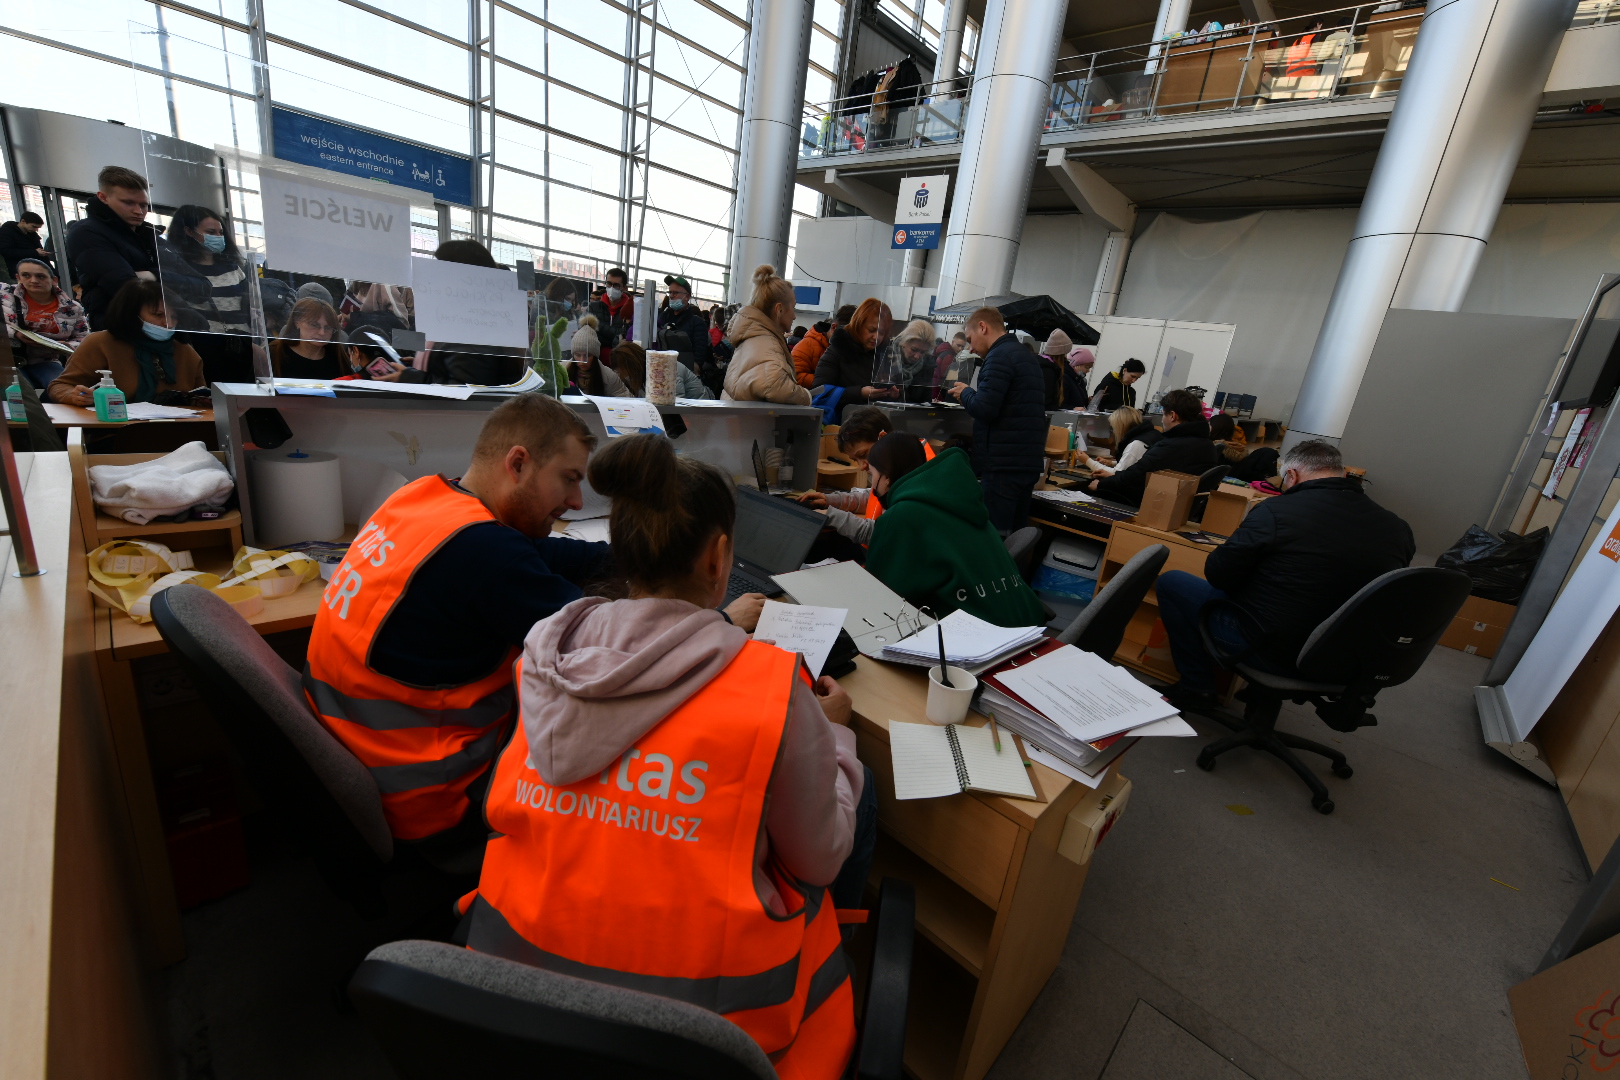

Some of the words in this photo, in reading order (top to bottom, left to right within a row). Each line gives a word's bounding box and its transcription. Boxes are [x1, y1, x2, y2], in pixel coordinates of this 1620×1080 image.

[300, 134, 344, 152] wejście
[347, 145, 405, 167] wschodnie
[319, 152, 354, 166] eastern
[356, 161, 394, 176] entrance
[323, 561, 362, 620] ER
[956, 574, 1023, 602] CULTU
[599, 748, 709, 805] tas
[515, 779, 702, 842] WOLONTARIUSZ
[1561, 1033, 1597, 1080] OKI
